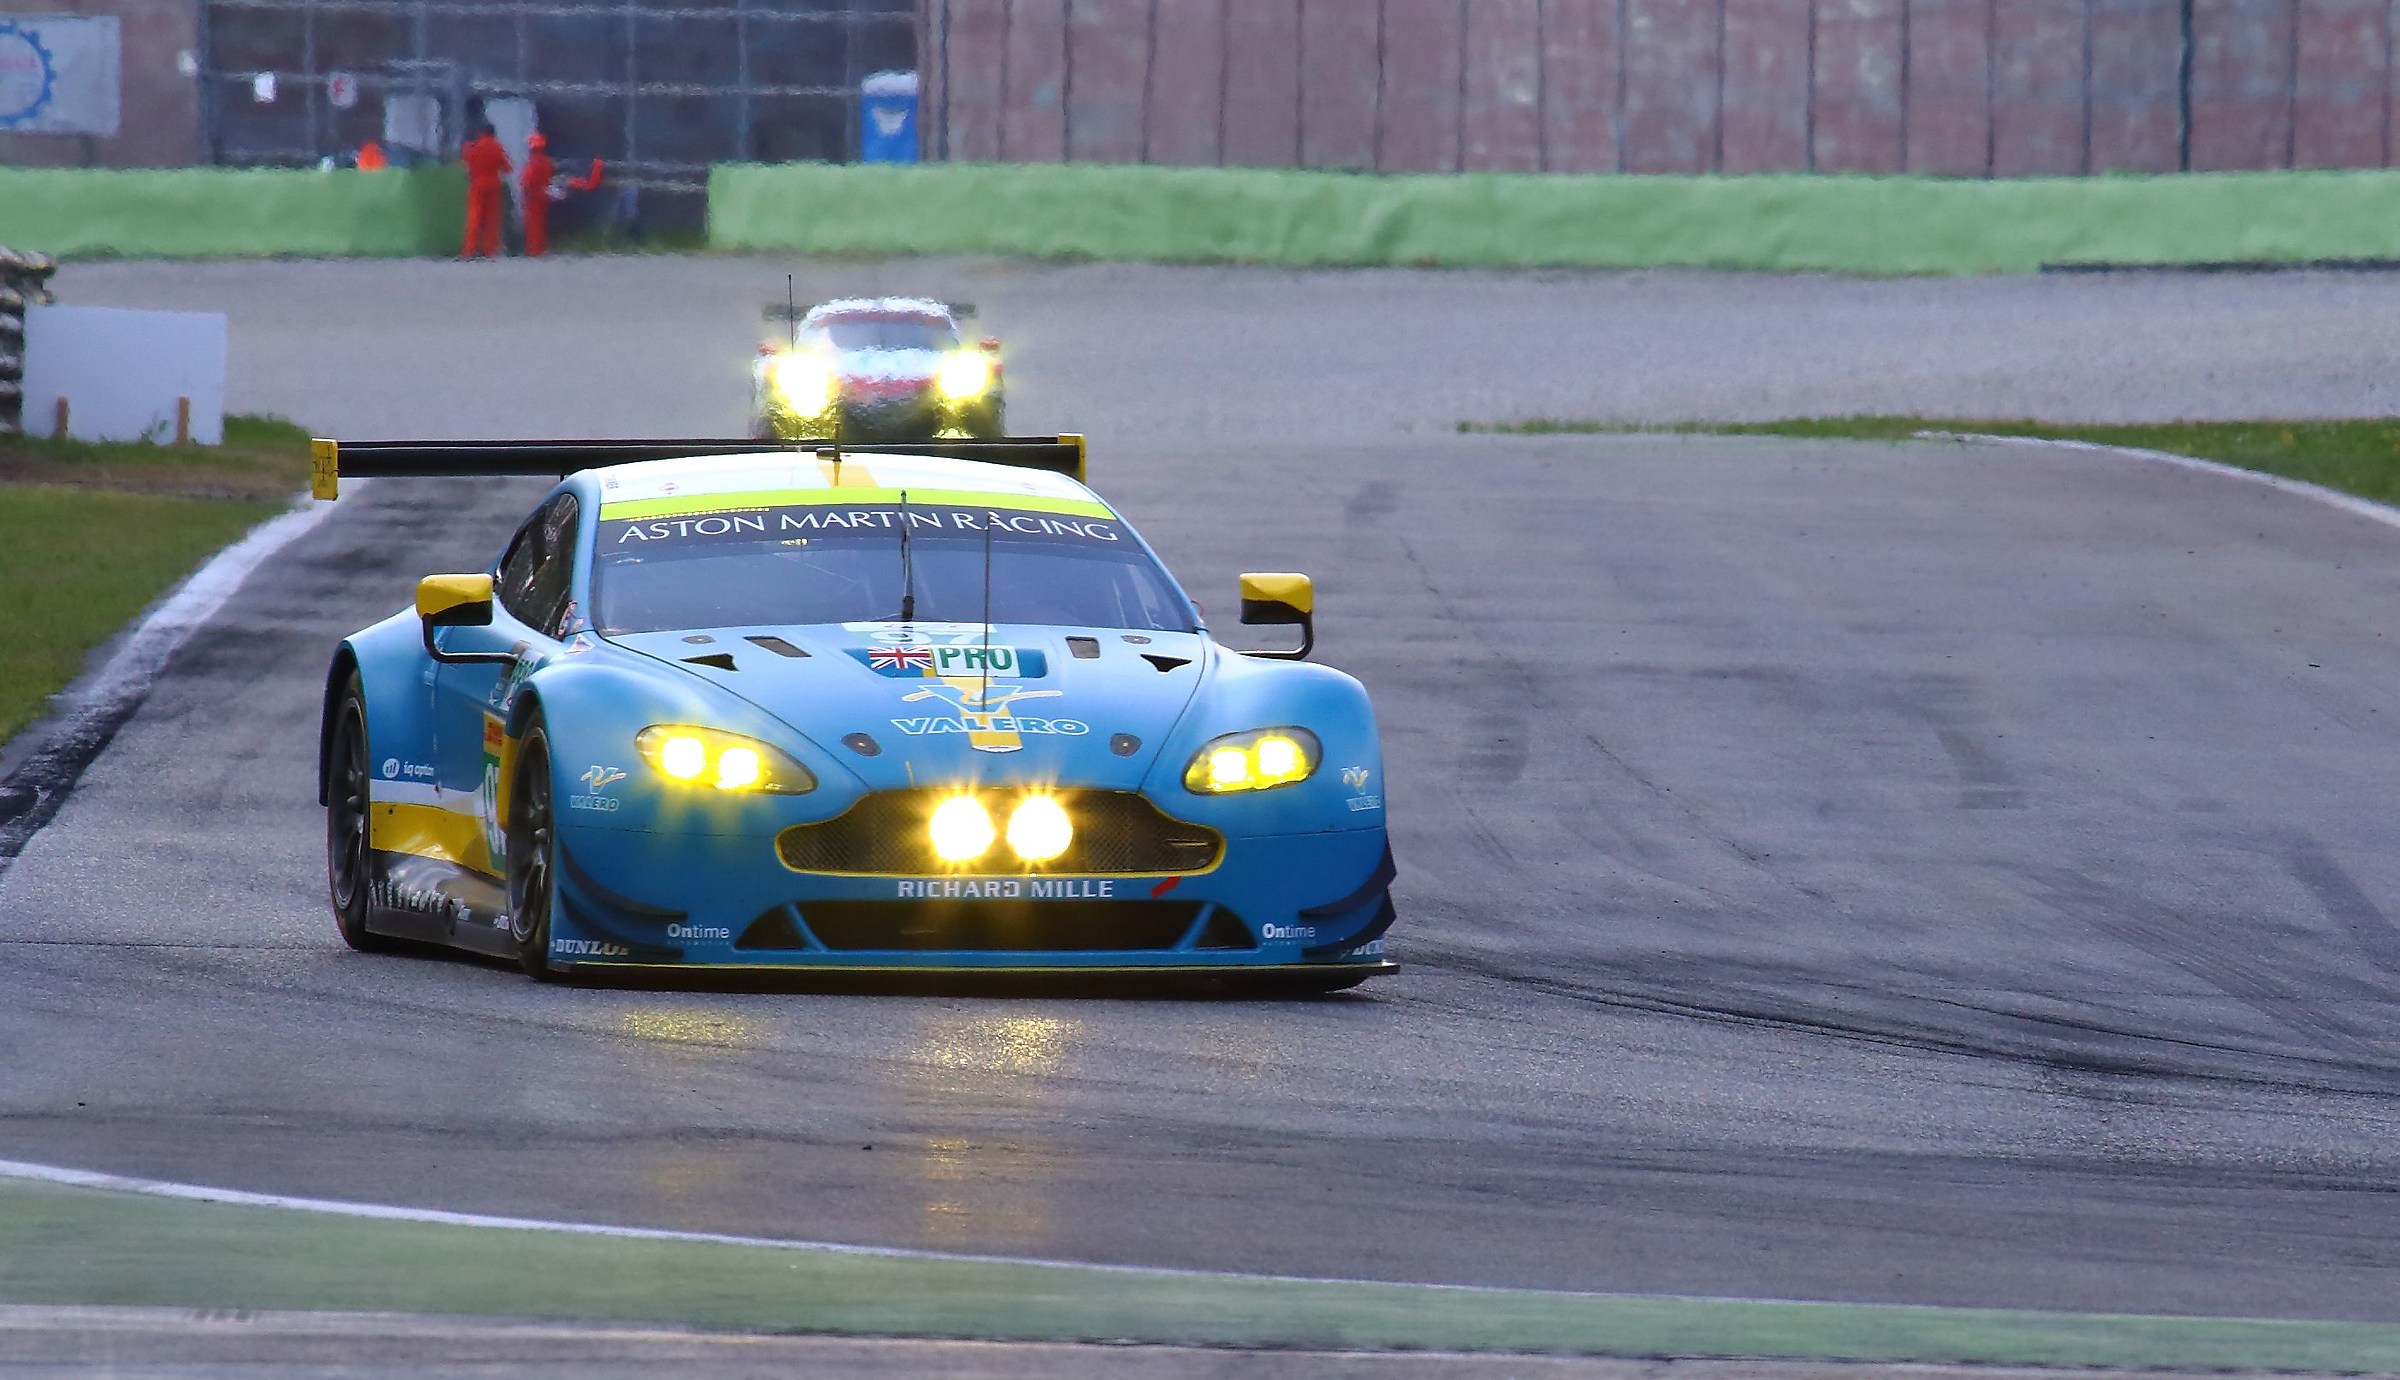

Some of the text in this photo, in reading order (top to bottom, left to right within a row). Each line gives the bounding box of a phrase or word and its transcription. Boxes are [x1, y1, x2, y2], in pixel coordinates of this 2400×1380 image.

[618, 515, 765, 543] ASTON
[781, 511, 942, 530] MARTIN
[951, 511, 1118, 541] RACING
[938, 648, 1012, 670] PRO
[890, 717, 1089, 735] VALERO
[897, 881, 1113, 898] RICHARD MILLE
[667, 923, 730, 939] Ontime
[1262, 923, 1316, 939] Ontime
